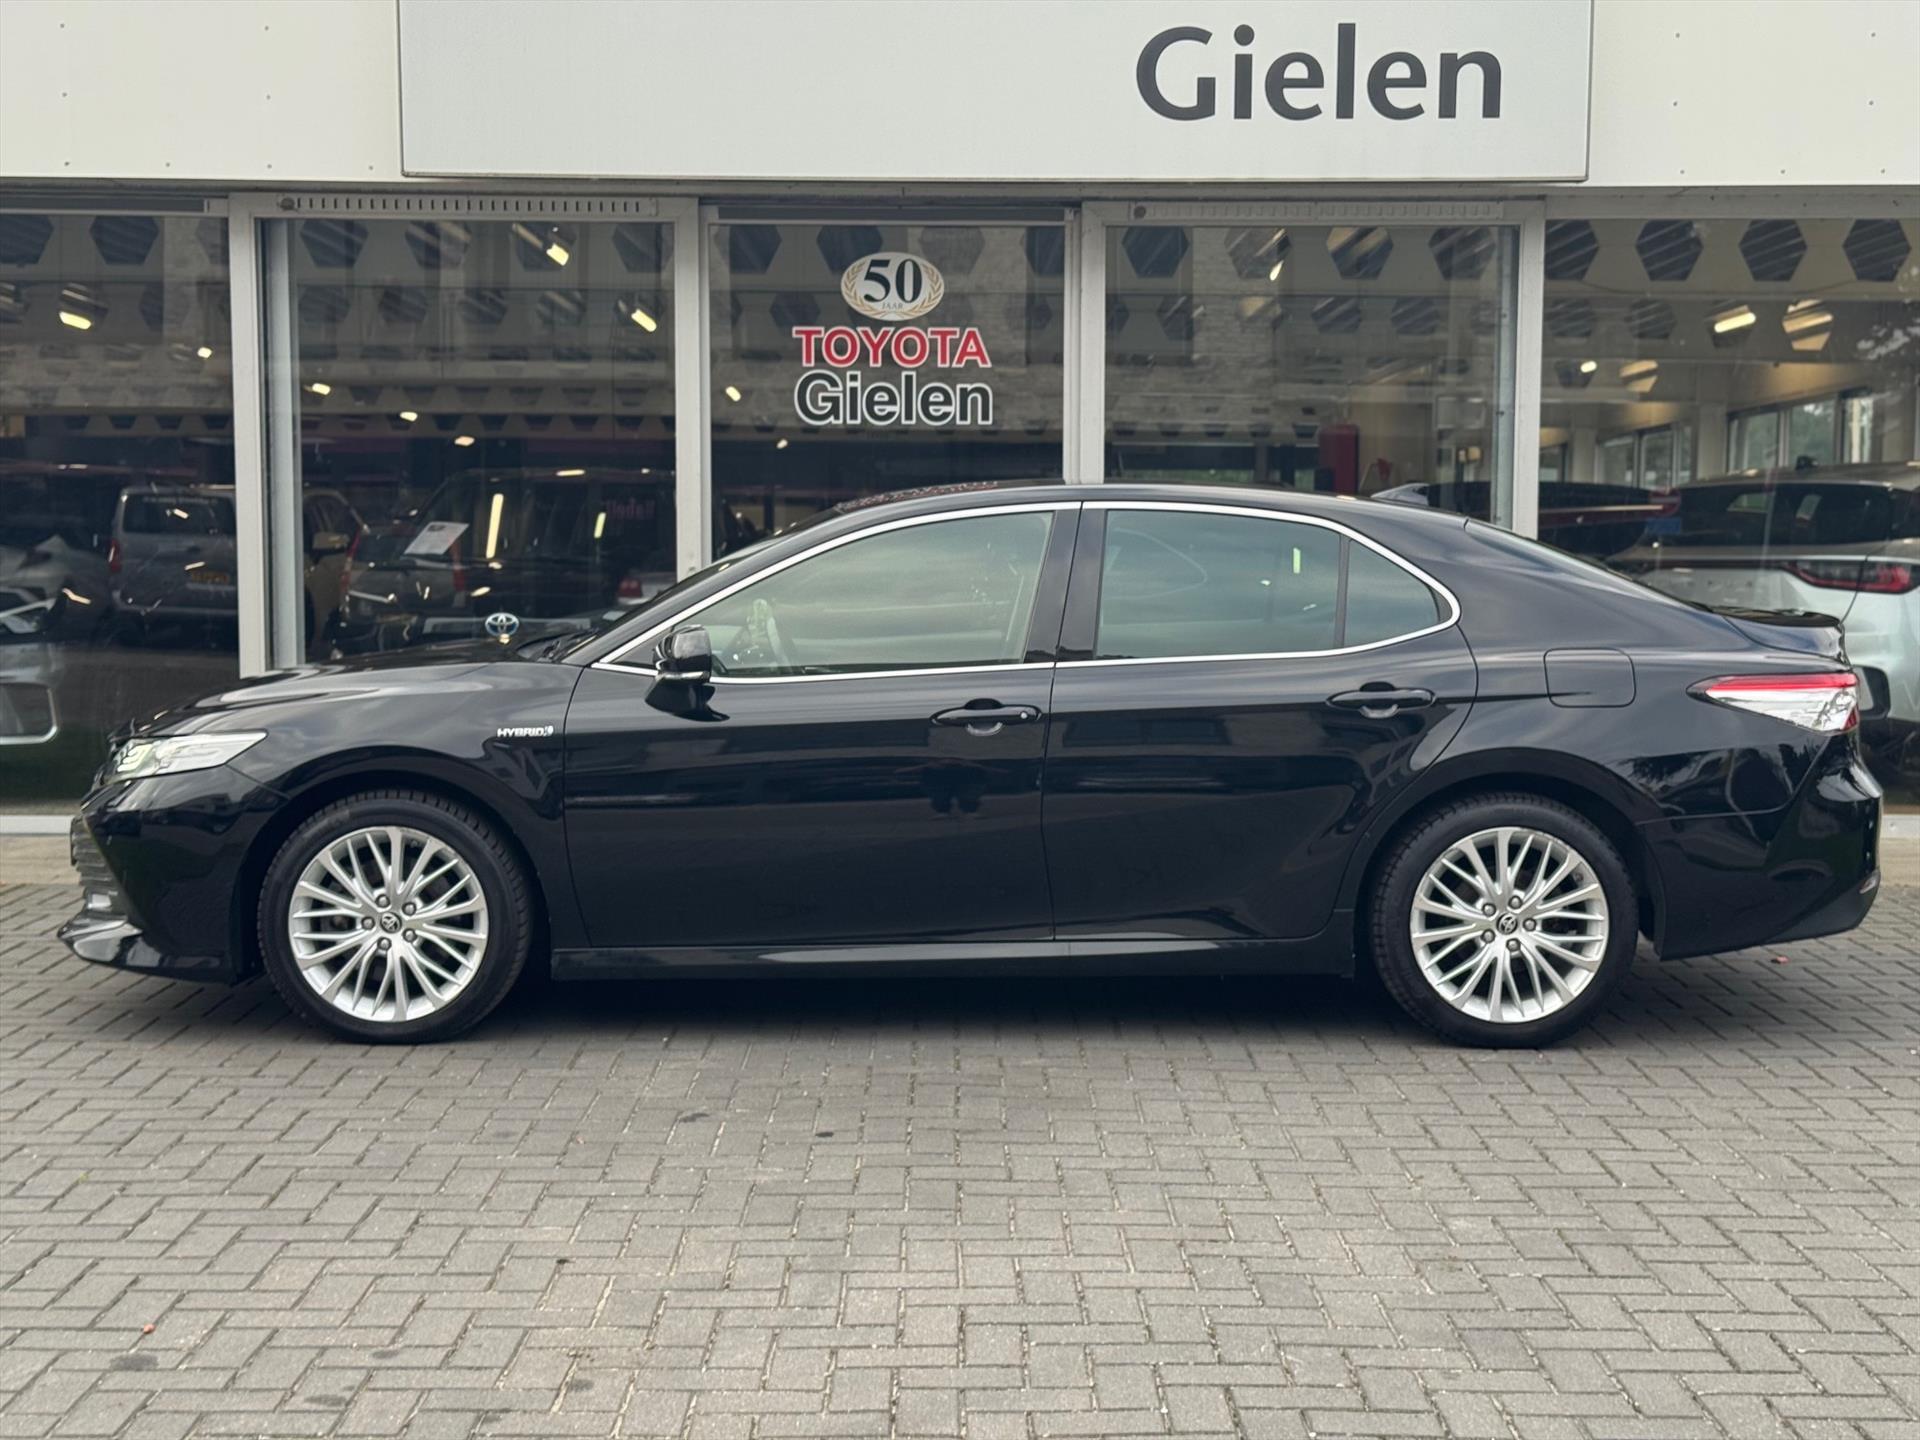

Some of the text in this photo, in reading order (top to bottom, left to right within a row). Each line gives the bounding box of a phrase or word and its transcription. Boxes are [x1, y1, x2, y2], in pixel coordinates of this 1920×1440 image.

[1136, 22, 1502, 121] Gielen
[863, 258, 923, 303] 50
[881, 302, 904, 310] JAAR
[792, 326, 992, 368] TOYOTA
[794, 369, 993, 426] Gielen
[497, 727, 545, 737] HYBRID
